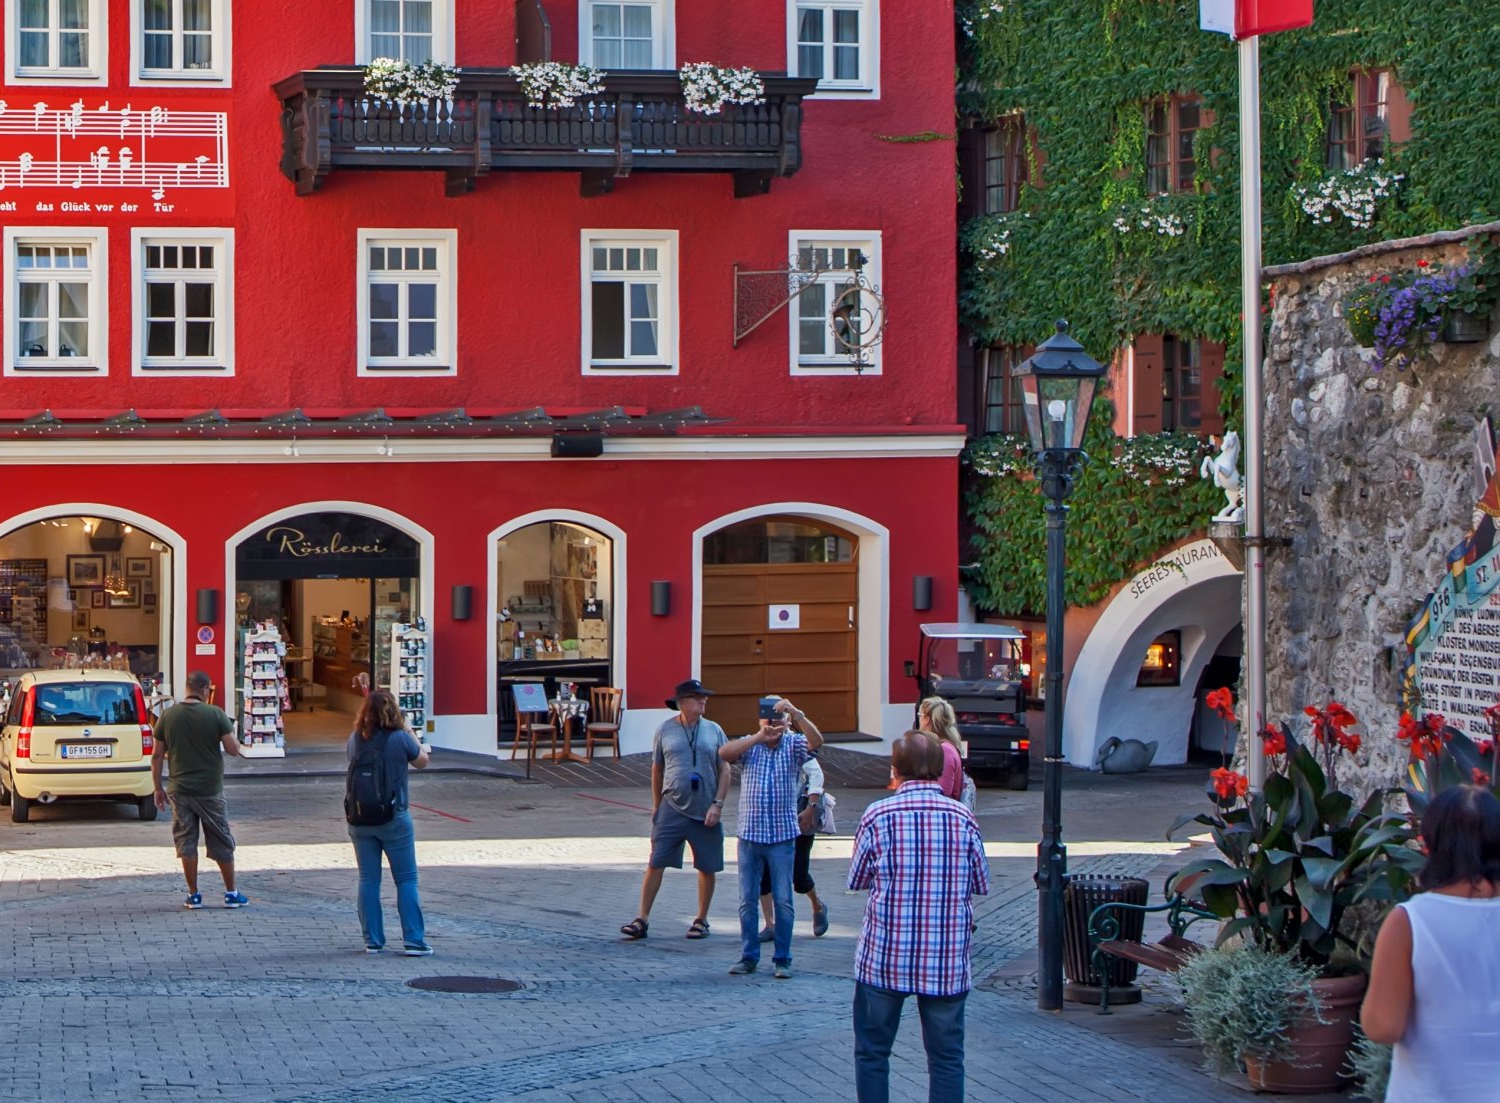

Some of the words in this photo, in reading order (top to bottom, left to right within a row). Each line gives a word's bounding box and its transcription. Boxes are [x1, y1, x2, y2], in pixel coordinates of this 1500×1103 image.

[35, 201, 54, 212] das
[60, 201, 92, 212] Glück
[94, 204, 115, 212] vor
[120, 202, 139, 212] der
[153, 201, 175, 213] Tür
[266, 526, 387, 557] Rösslerei
[1130, 545, 1223, 600] SEERESTAURAN
[1433, 587, 1450, 622] 976
[1454, 605, 1474, 622] KÖNIG
[1443, 620, 1456, 633] TEIL
[1437, 635, 1467, 650] KLOSTER
[1420, 651, 1456, 668] WOLFGANG
[1420, 662, 1456, 684] GRÜNDUNG
[1457, 669, 1470, 682] DER
[1471, 671, 1494, 686] ERSTEN
[1420, 682, 1439, 698] GANG
[1464, 687, 1473, 700] IN
[69, 746, 78, 755] GF
[84, 746, 97, 755] 155
